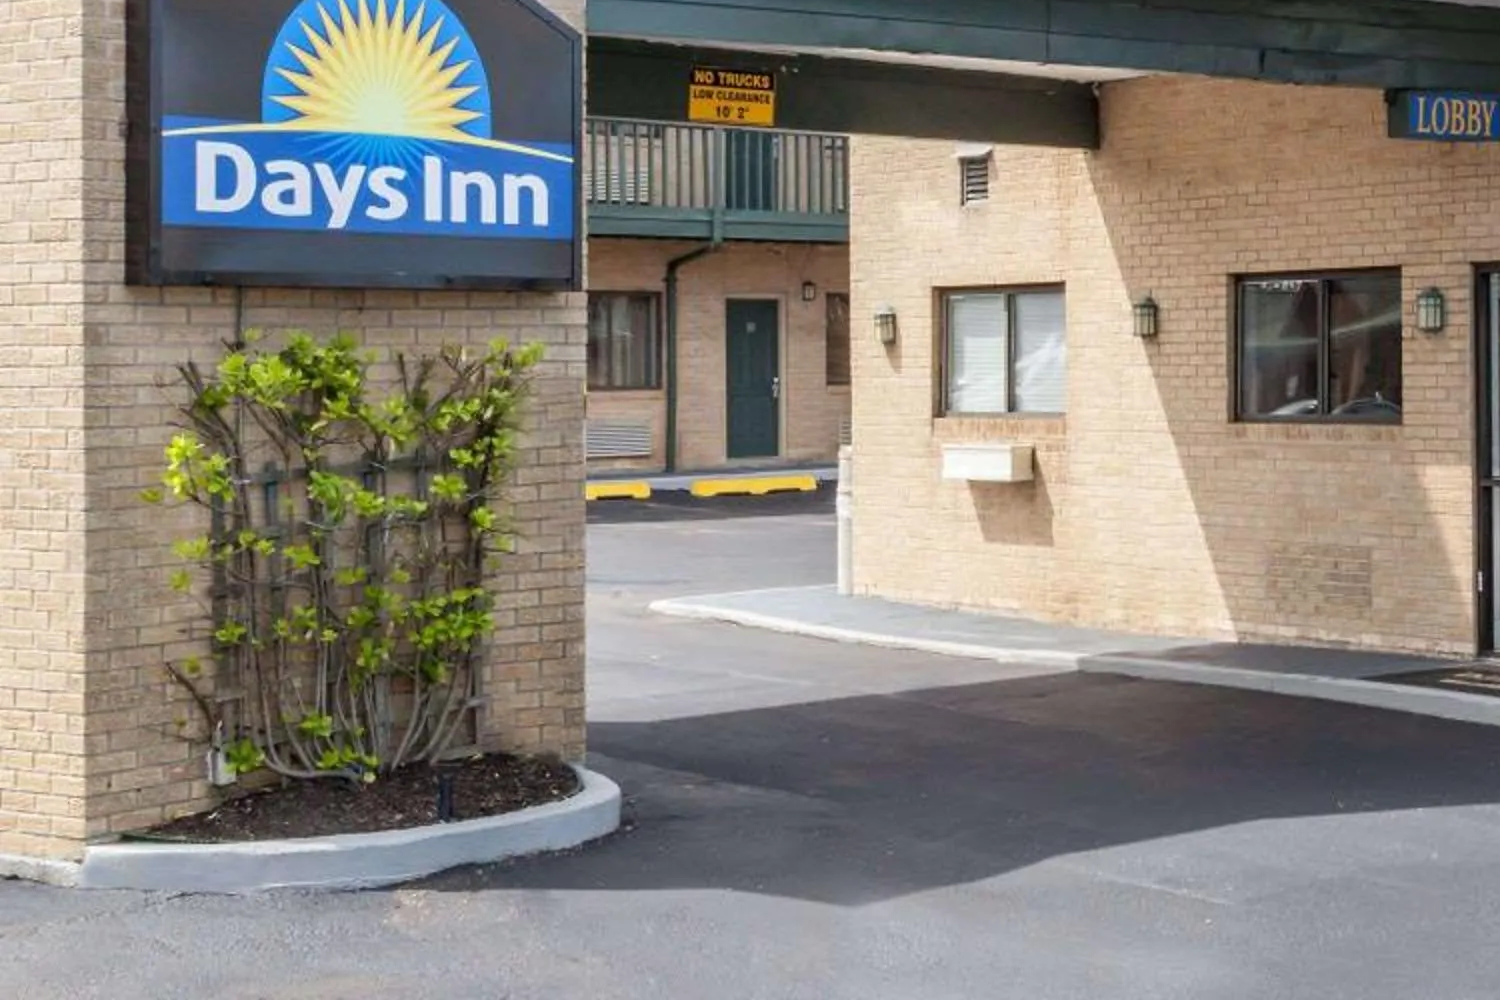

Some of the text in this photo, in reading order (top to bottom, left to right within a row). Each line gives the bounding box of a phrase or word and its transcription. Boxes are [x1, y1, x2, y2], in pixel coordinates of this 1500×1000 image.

[694, 69, 770, 89] NO TRUCKS
[692, 89, 770, 105] LOW CLEARANCE
[1416, 96, 1498, 137] LOBBY
[195, 139, 550, 229] Days Inn
